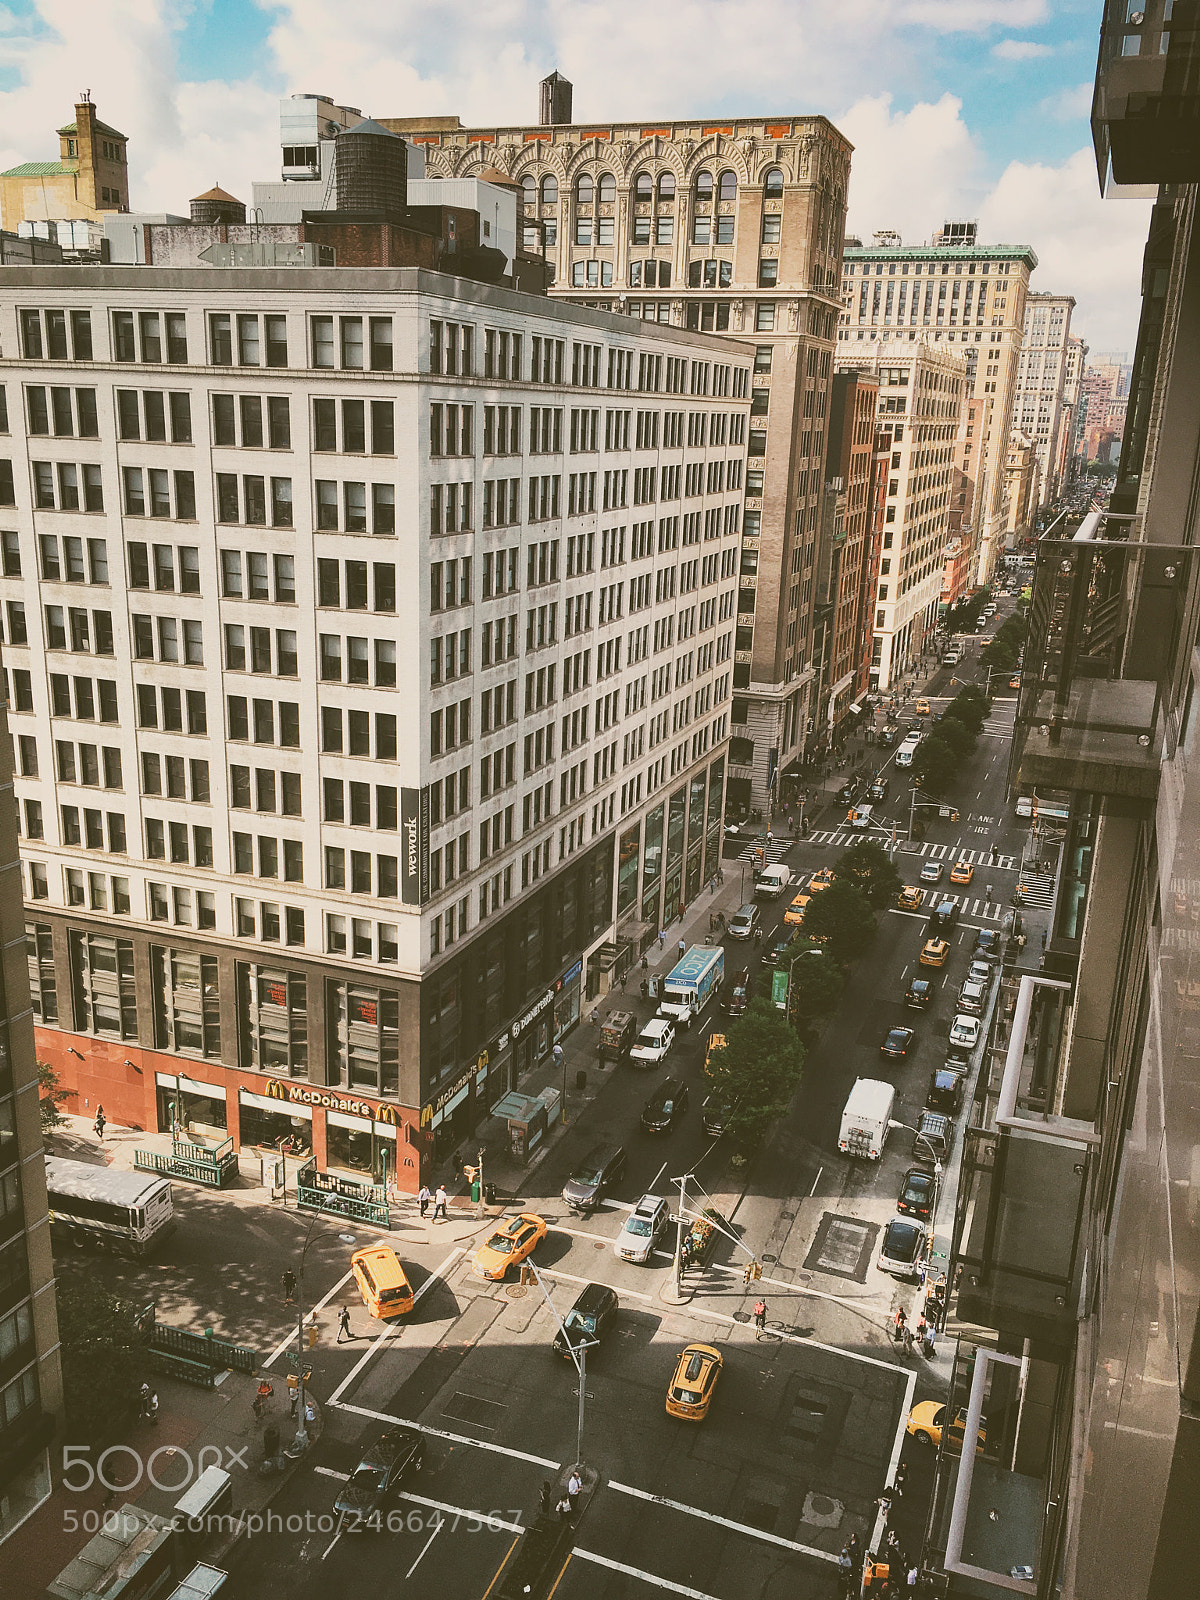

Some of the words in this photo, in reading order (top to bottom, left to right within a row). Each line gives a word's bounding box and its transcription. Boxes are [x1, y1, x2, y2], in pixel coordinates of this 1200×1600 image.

[404, 816, 417, 877] wework
[680, 954, 710, 976] ZICO
[289, 1087, 370, 1115] McDonald's
